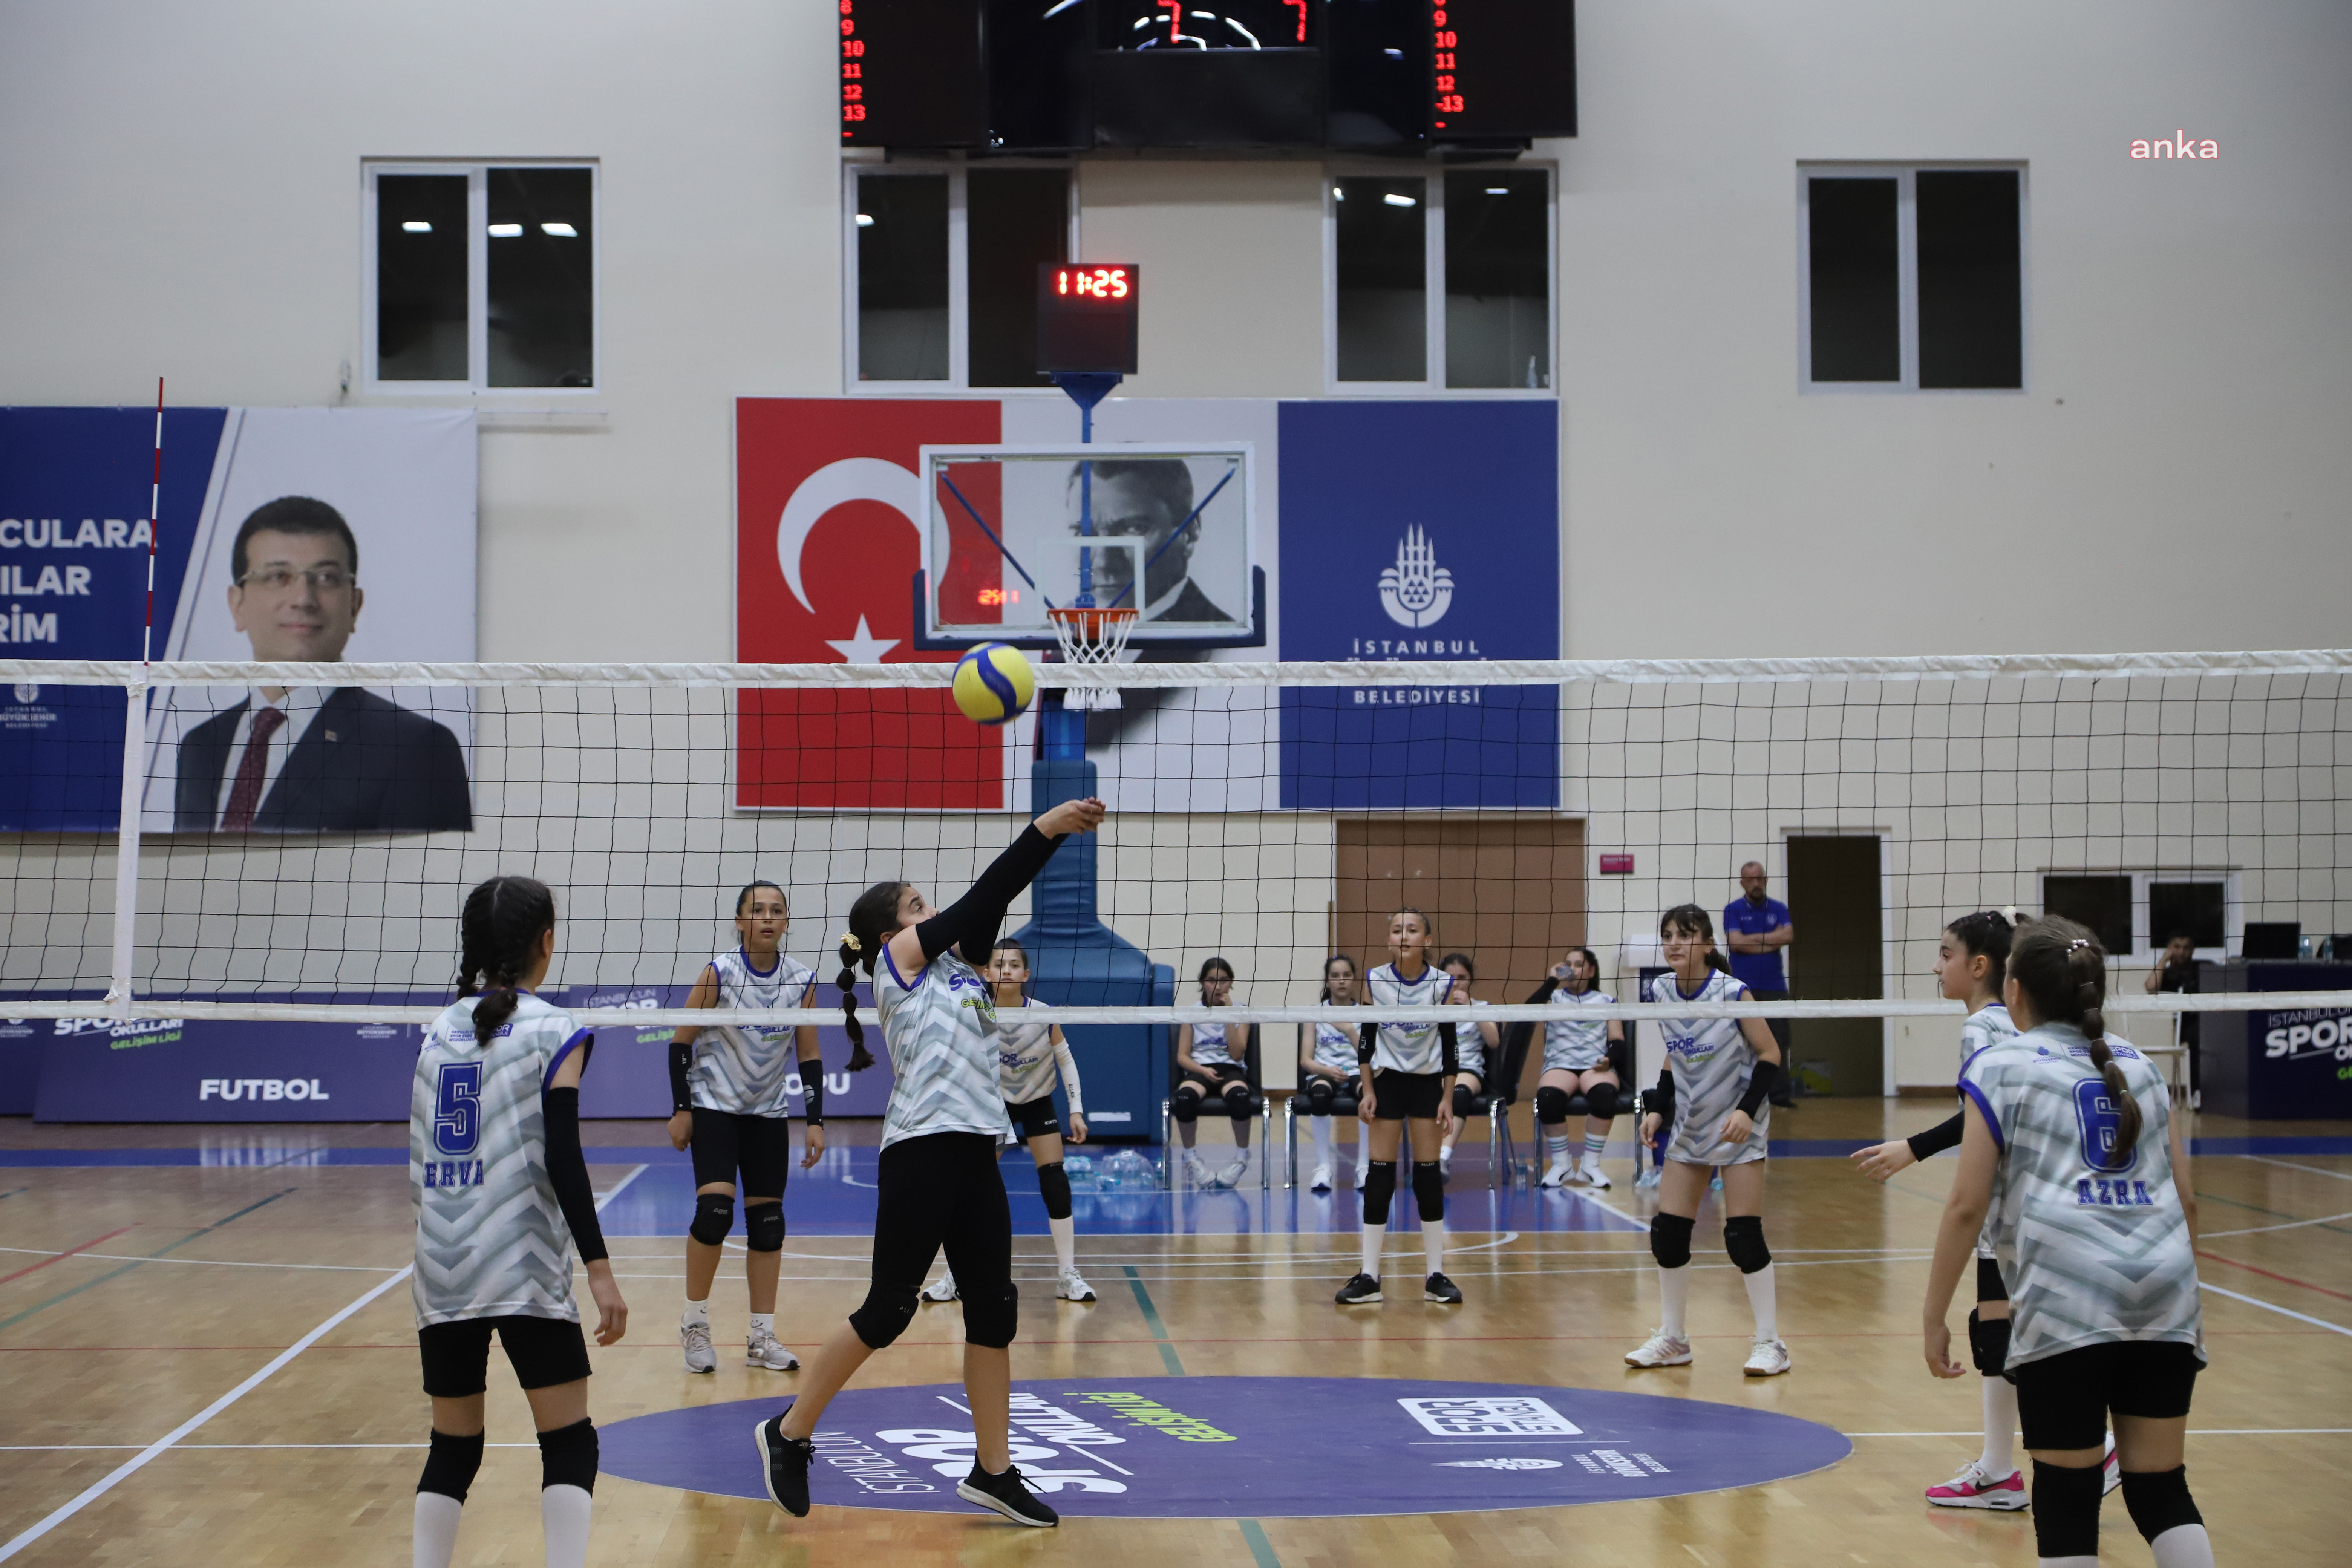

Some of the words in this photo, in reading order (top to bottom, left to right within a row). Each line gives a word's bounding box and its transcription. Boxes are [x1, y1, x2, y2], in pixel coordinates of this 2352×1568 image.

[1433, 10, 1447, 27] 9
[841, 19, 854, 36] 9
[1435, 31, 1457, 48] 10
[842, 40, 865, 57] 10
[1435, 52, 1456, 70] 11
[842, 63, 862, 78] 11
[842, 84, 862, 100] 12
[1436, 75, 1455, 92] 12
[842, 104, 866, 121] 13
[1059, 269, 1128, 298] 11:25
[1353, 638, 1479, 655] İSTANBUL
[1354, 687, 1480, 704] BELEDİYESİ
[53, 1018, 132, 1036] SP
[1666, 1037, 1694, 1053] SPOR
[2265, 1015, 2352, 1058] SPOR
[999, 1053, 1017, 1064] OR
[2334, 1043, 2352, 1061] O
[199, 1078, 330, 1101] FUTBOL
[433, 1061, 483, 1156] 5
[2073, 1078, 2138, 1174] 6
[423, 1159, 484, 1188] ERVA
[2077, 1179, 2153, 1205] AZRA
[1063, 1392, 1163, 1407] LİGİ
[1417, 1400, 1514, 1432] SPOR
[1111, 1408, 1238, 1442] GELİŞİM
[875, 1429, 1127, 1494] SPOR
